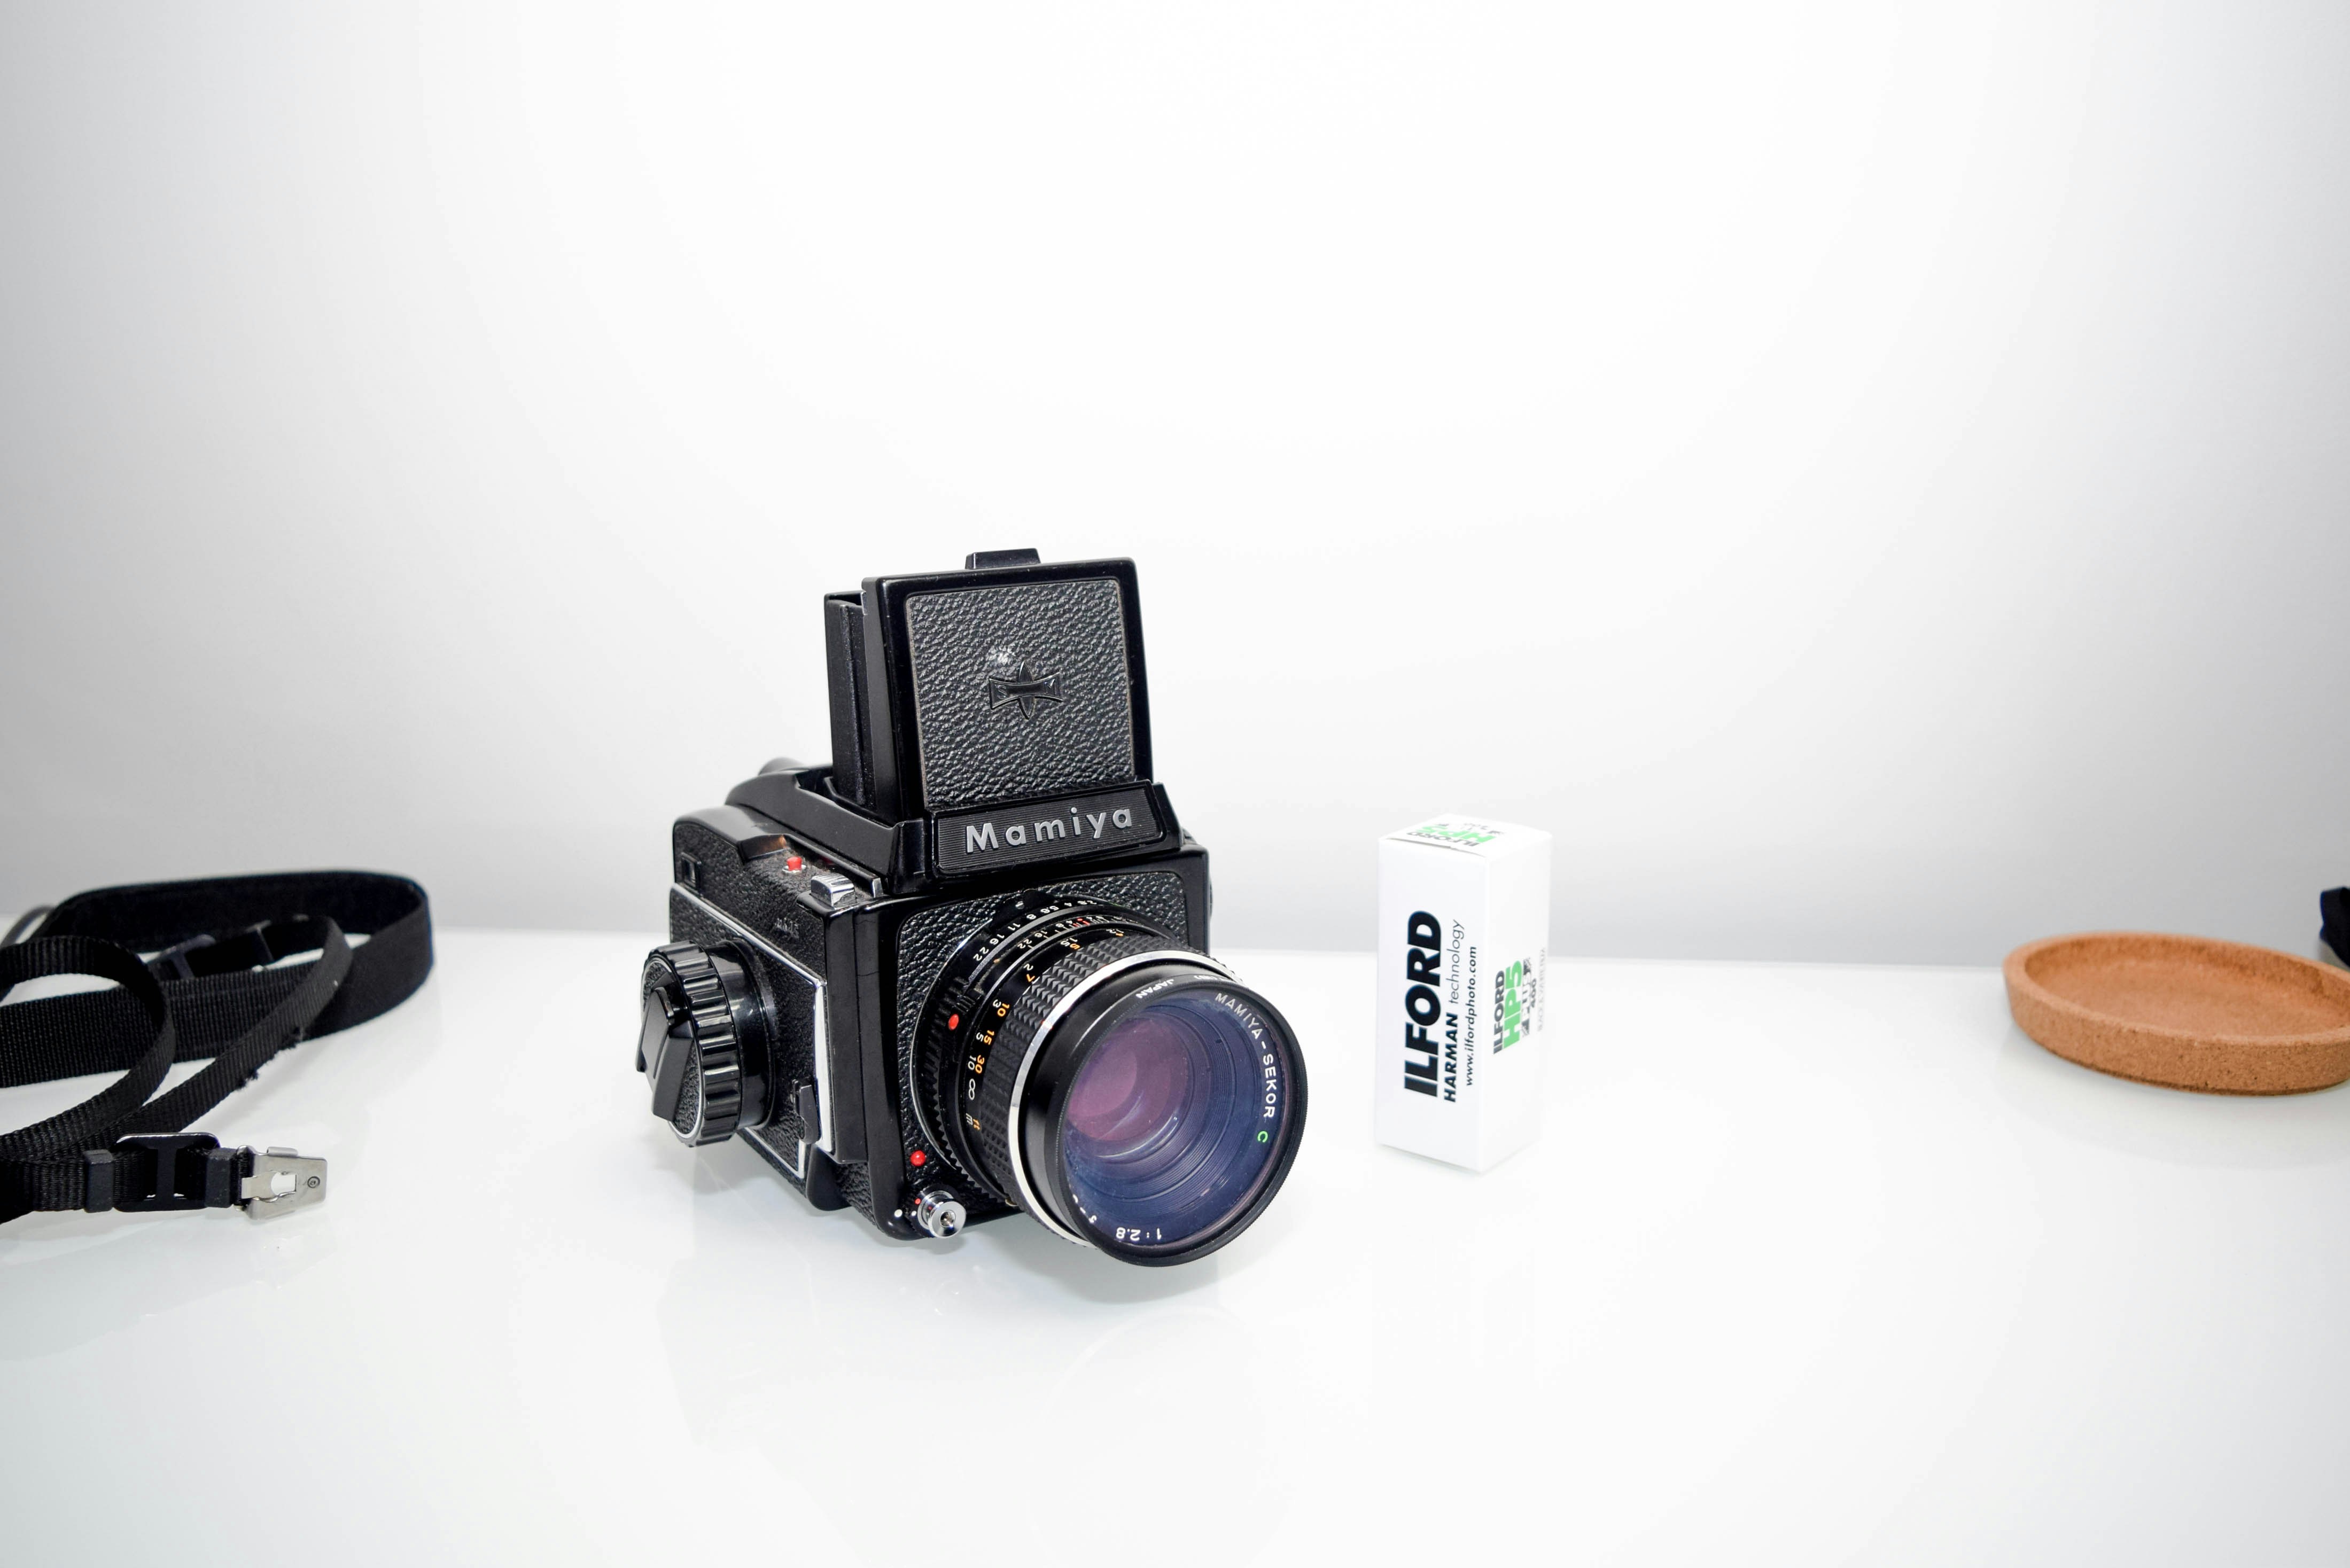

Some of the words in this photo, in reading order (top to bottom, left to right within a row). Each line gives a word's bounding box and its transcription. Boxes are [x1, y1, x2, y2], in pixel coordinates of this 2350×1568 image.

[966, 807, 1132, 853] Mamiya
[1406, 831, 1480, 846] ILFORD
[1040, 906, 1059, 914] 5.6
[1008, 923, 1021, 931] 11
[990, 934, 1005, 945] 16
[1017, 939, 1032, 949] 22
[1060, 938, 1078, 947] 1.5
[973, 947, 989, 961] 22
[1446, 919, 1465, 1004] technology
[1026, 973, 1036, 982] 7
[1135, 979, 1174, 999] JAPAN
[993, 999, 1001, 1008] 3
[997, 1003, 1010, 1017] 10
[1403, 910, 1442, 1098] ILFORD
[1504, 960, 1522, 1049] HP5
[1465, 946, 1477, 1086] www.ilfordphoto.com
[1493, 970, 1505, 1054] ILFORD
[976, 1032, 984, 1041] 5
[983, 1030, 994, 1045] 15
[968, 1055, 977, 1070] 10
[975, 1055, 985, 1074] 30
[1444, 1012, 1458, 1103] HARMAN
[1257, 1130, 1268, 1143] C
